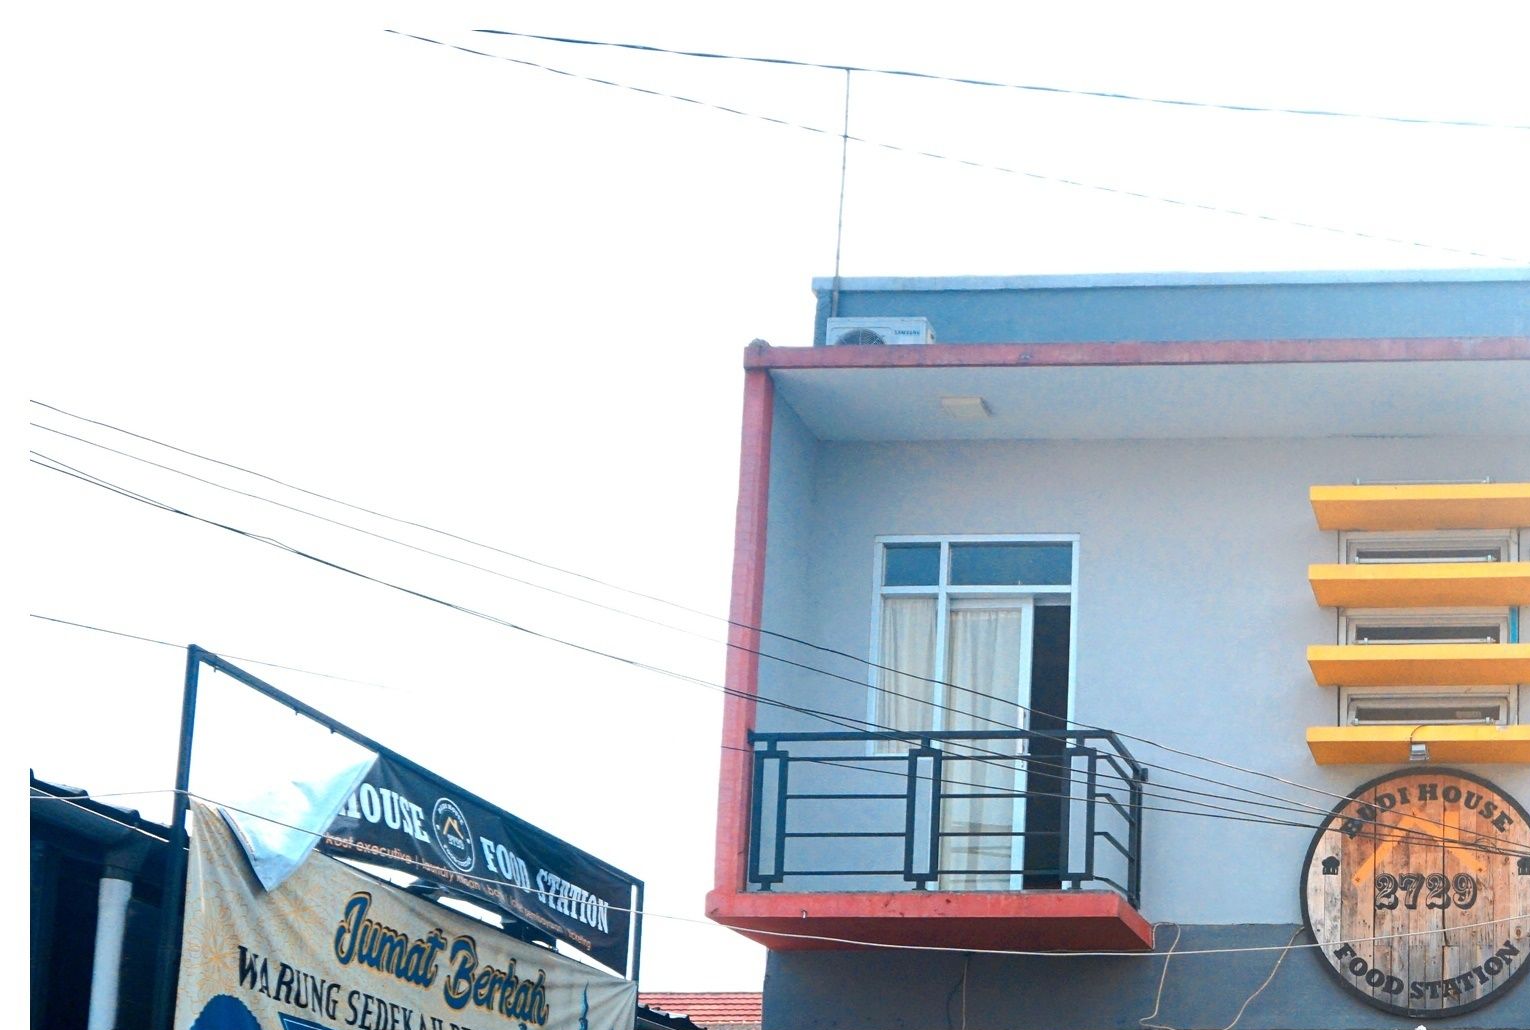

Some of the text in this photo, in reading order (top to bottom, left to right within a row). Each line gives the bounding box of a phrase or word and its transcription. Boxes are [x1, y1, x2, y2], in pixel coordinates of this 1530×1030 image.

[1340, 783, 1514, 840] BUDI HOUSE
[480, 836, 531, 894] FOOD
[536, 868, 609, 934] STATION
[1374, 872, 1478, 911] 2729
[238, 945, 341, 1021] WARUNG
[334, 891, 549, 1027] Jumat Berkah
[1333, 940, 1521, 1000] FOOD STATION
